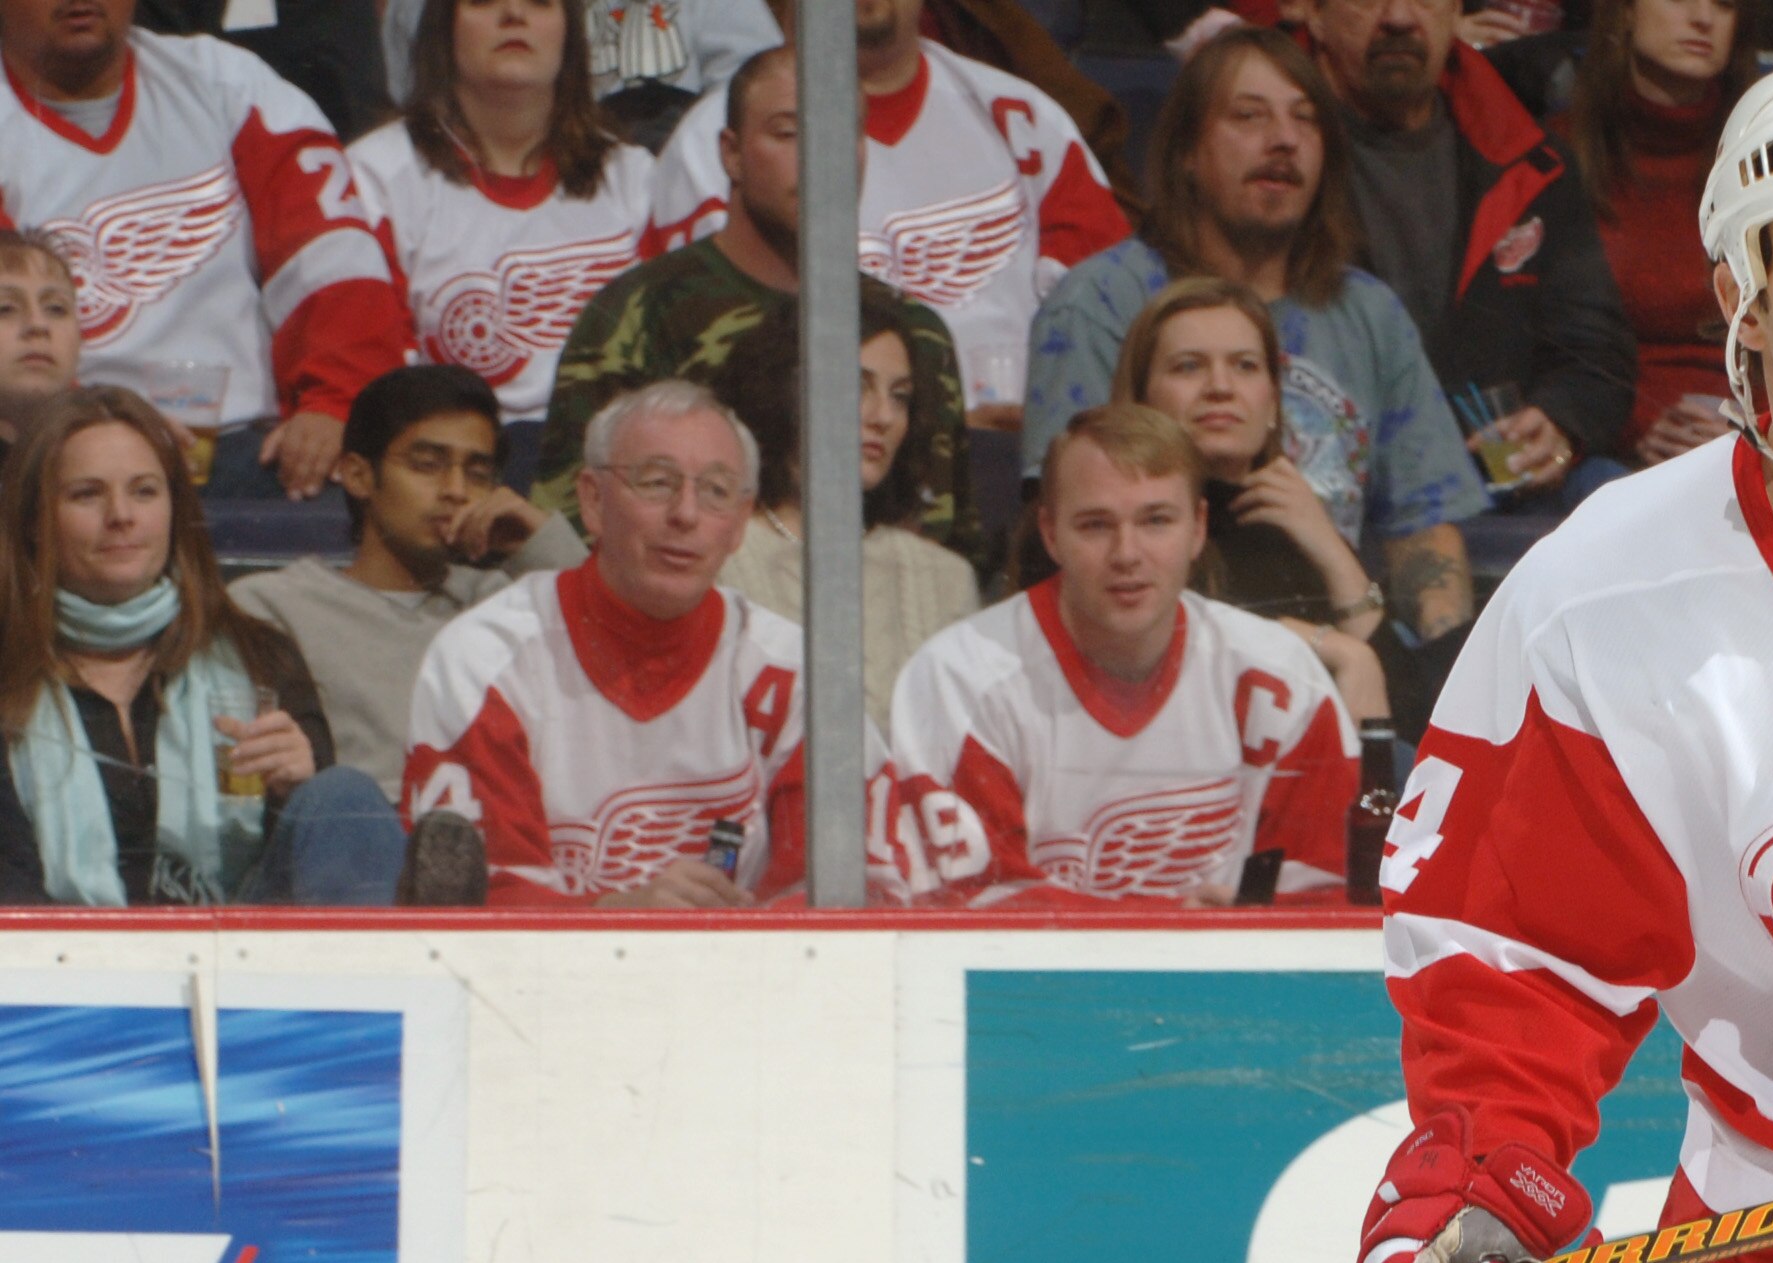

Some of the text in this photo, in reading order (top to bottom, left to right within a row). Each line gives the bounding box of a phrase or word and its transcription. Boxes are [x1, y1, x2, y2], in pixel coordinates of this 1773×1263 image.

[992, 97, 1042, 176] C
[743, 665, 799, 753] A
[1234, 669, 1290, 767] C
[896, 791, 992, 885] 19
